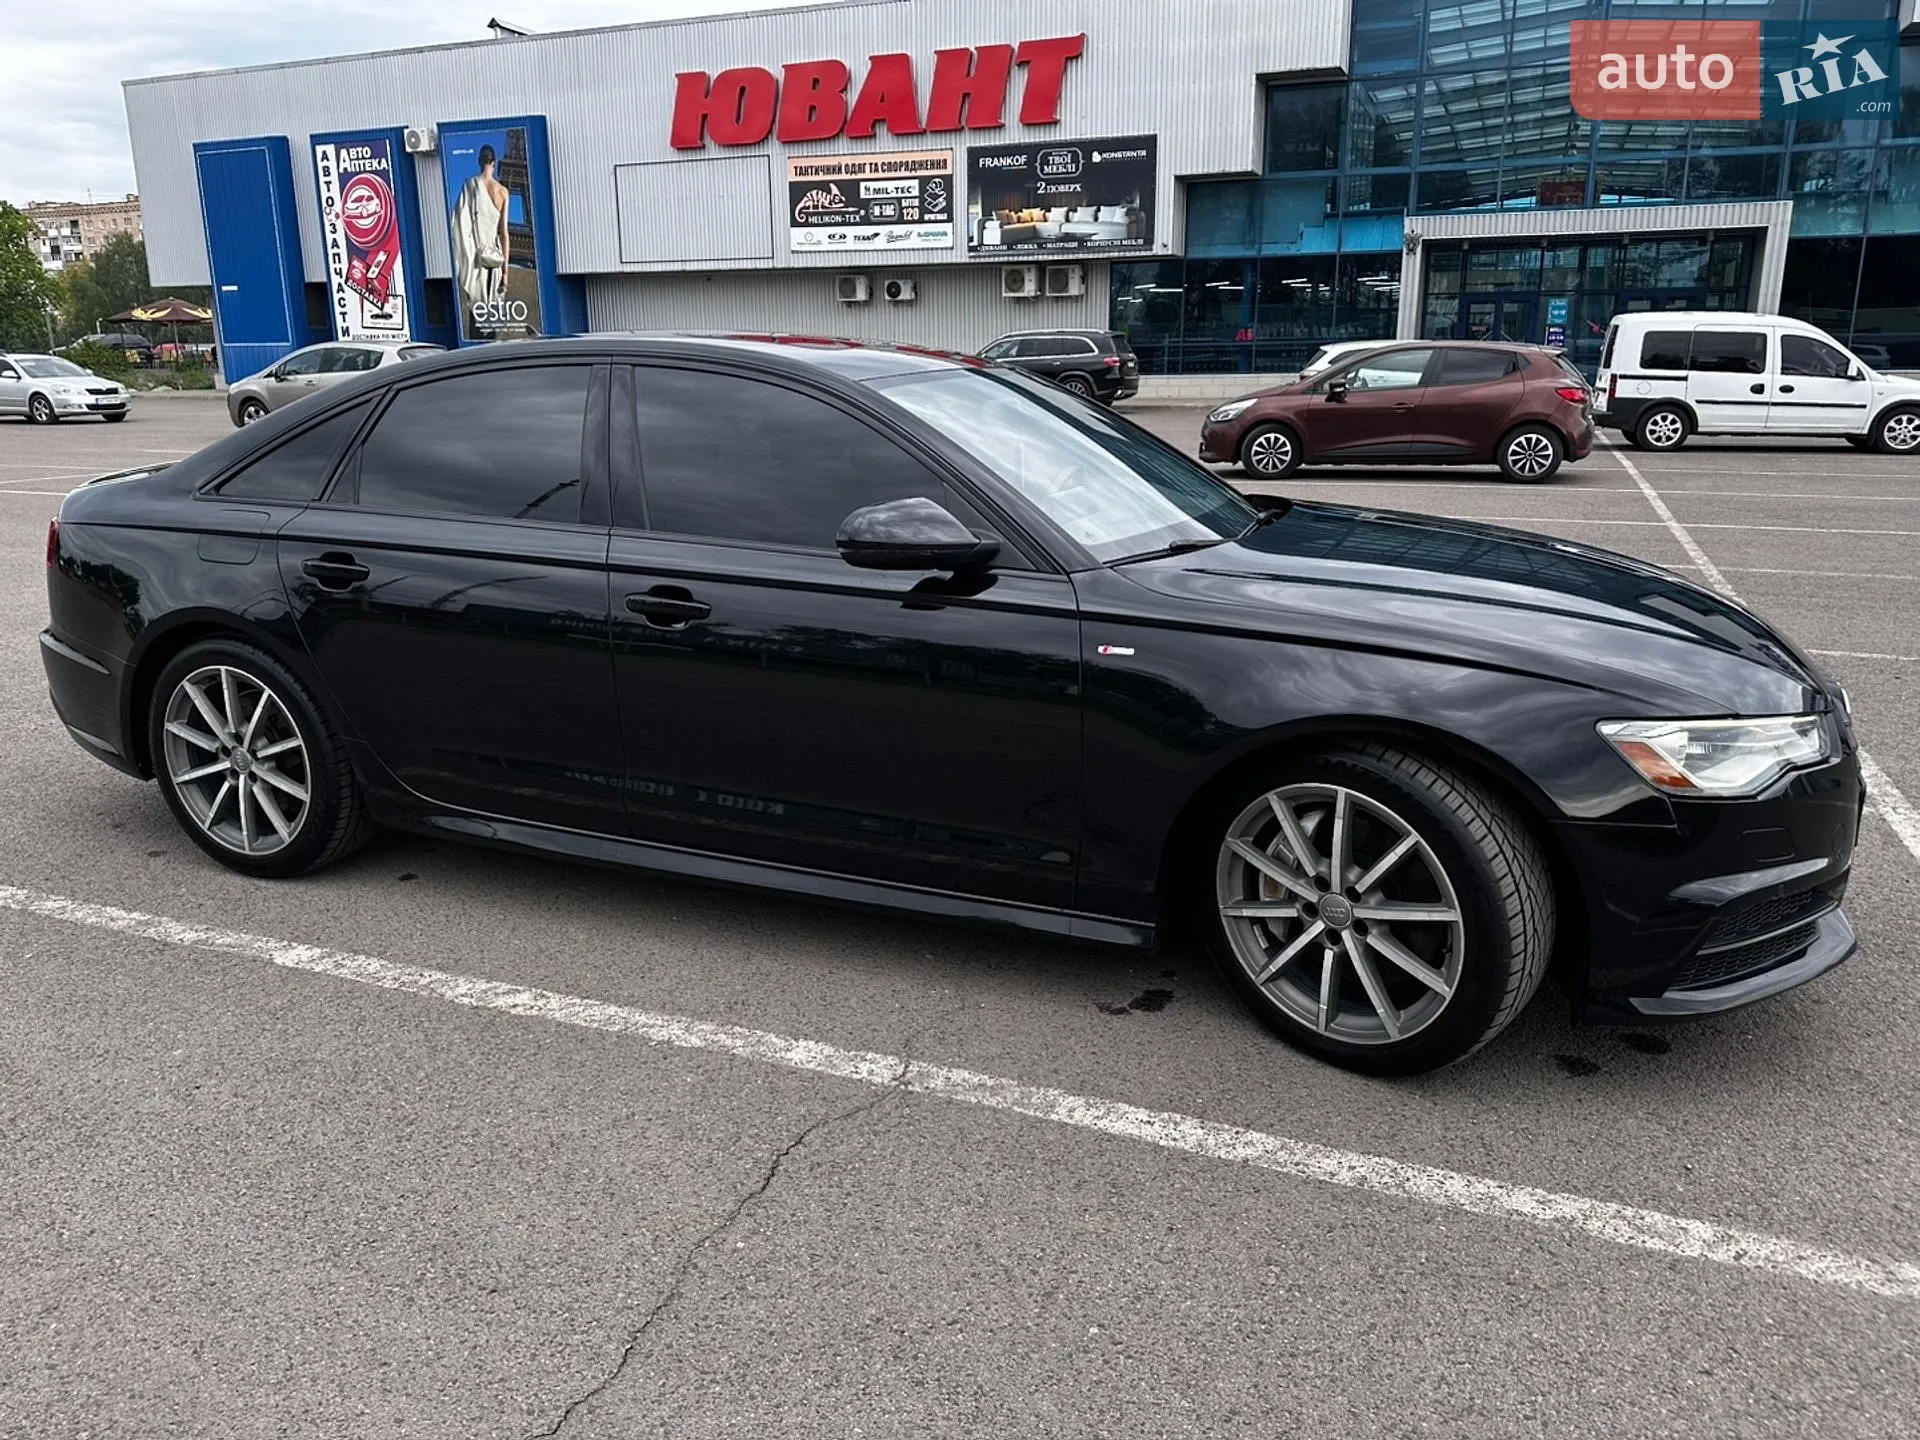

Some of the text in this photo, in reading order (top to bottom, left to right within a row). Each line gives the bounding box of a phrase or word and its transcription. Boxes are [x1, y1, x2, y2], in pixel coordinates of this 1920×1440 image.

[671, 33, 1087, 149] ЮВАНТ
[339, 148, 388, 173] АПТЕКА
[978, 155, 1028, 168] FRANKOF
[1047, 153, 1072, 164] ТВОЇ
[793, 158, 948, 177] ТАКТИЧНИЙ ОДЯГ ТА СПОРЯДЖЕННЯ
[1043, 163, 1075, 174] МЕБЛІ
[1036, 181, 1082, 194] 2 ПОВЕРХ
[808, 214, 860, 224] HELIKON-TEX
[902, 207, 919, 221] 120
[472, 298, 528, 321] estro
